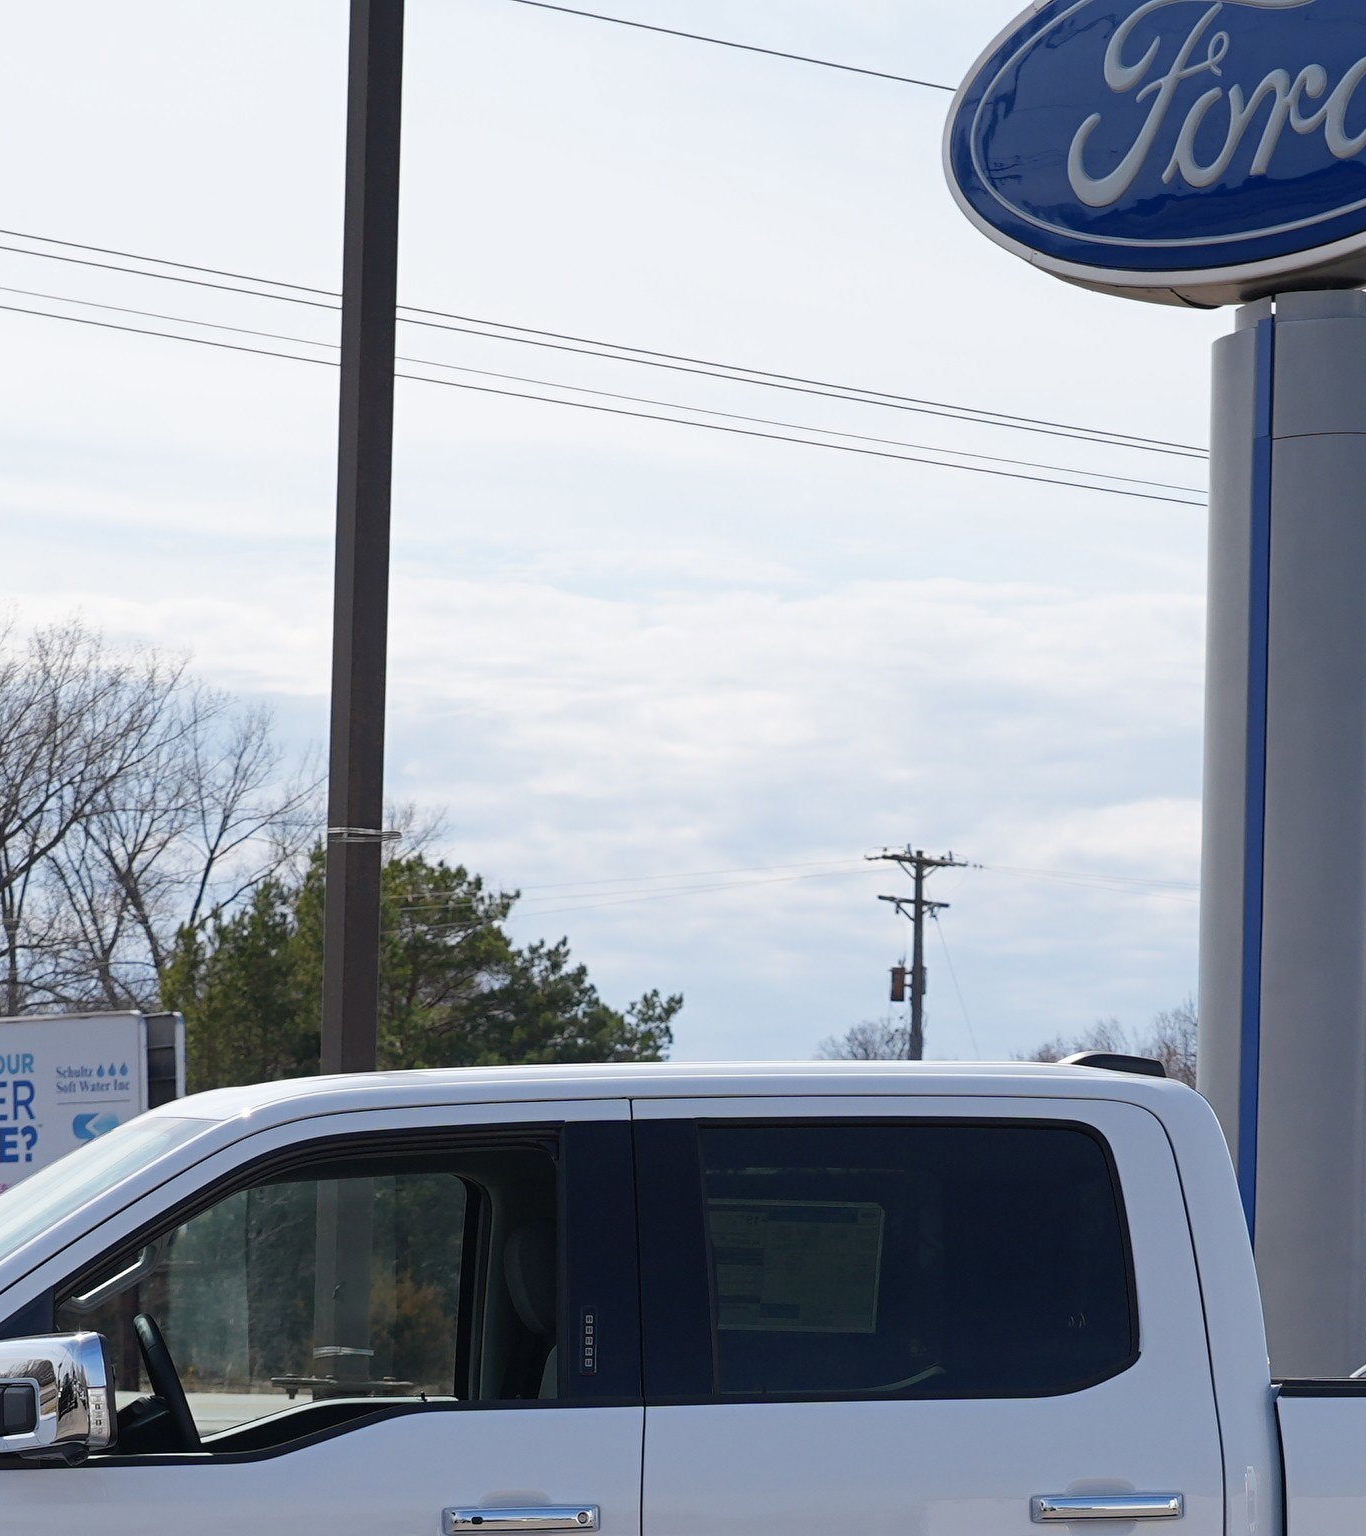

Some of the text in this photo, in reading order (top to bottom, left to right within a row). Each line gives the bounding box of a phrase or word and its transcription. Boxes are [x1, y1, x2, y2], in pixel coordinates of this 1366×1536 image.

[56, 1065, 93, 1078] Schultz
[56, 1079, 130, 1093] Soft Water Inc
